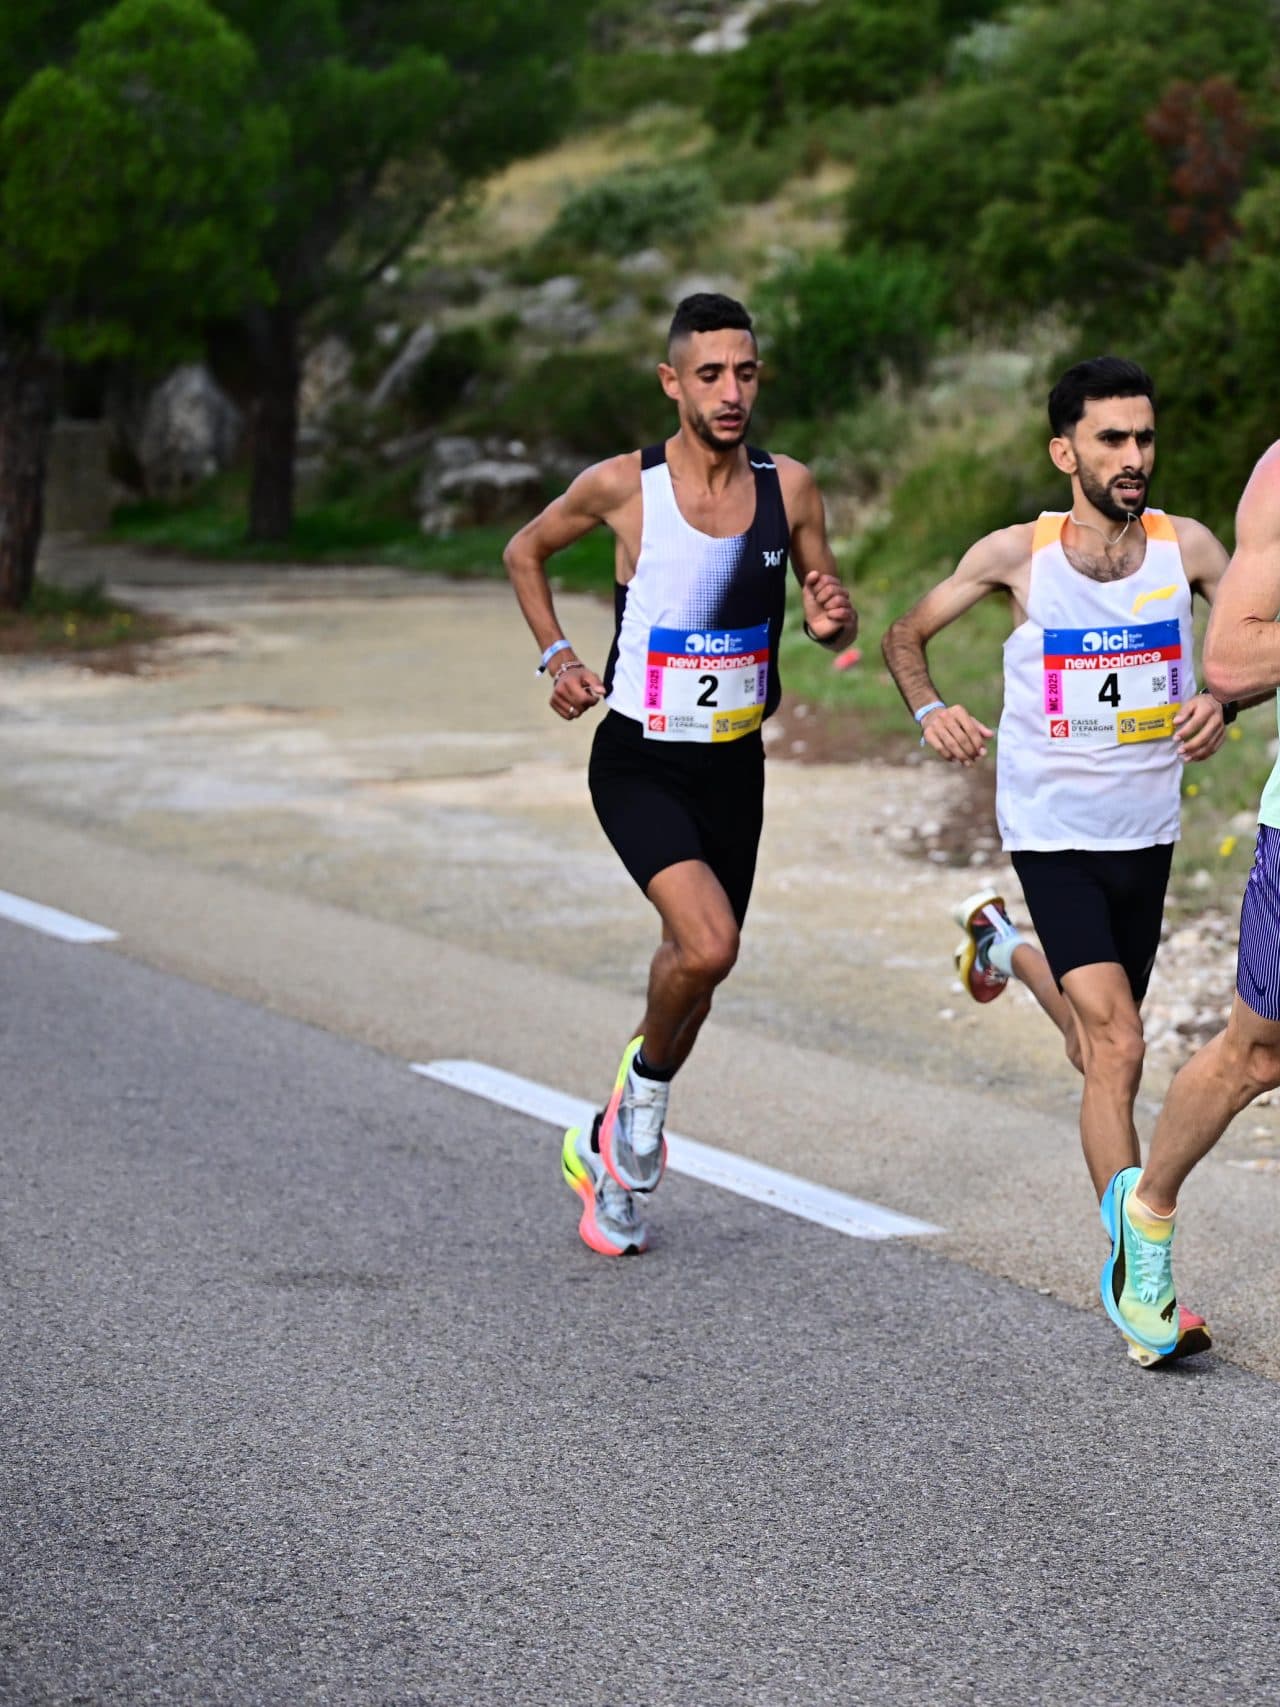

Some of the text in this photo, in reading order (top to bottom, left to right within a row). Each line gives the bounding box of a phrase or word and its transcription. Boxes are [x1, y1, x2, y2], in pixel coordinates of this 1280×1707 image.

[705, 633, 730, 653] ici
[1102, 629, 1128, 651] ici
[666, 654, 755, 670] new balance
[1065, 651, 1161, 669] new balance
[648, 669, 660, 706] MC 2025
[696, 674, 719, 707] 2
[1048, 673, 1059, 712] MC 2025
[1098, 672, 1121, 707] 4
